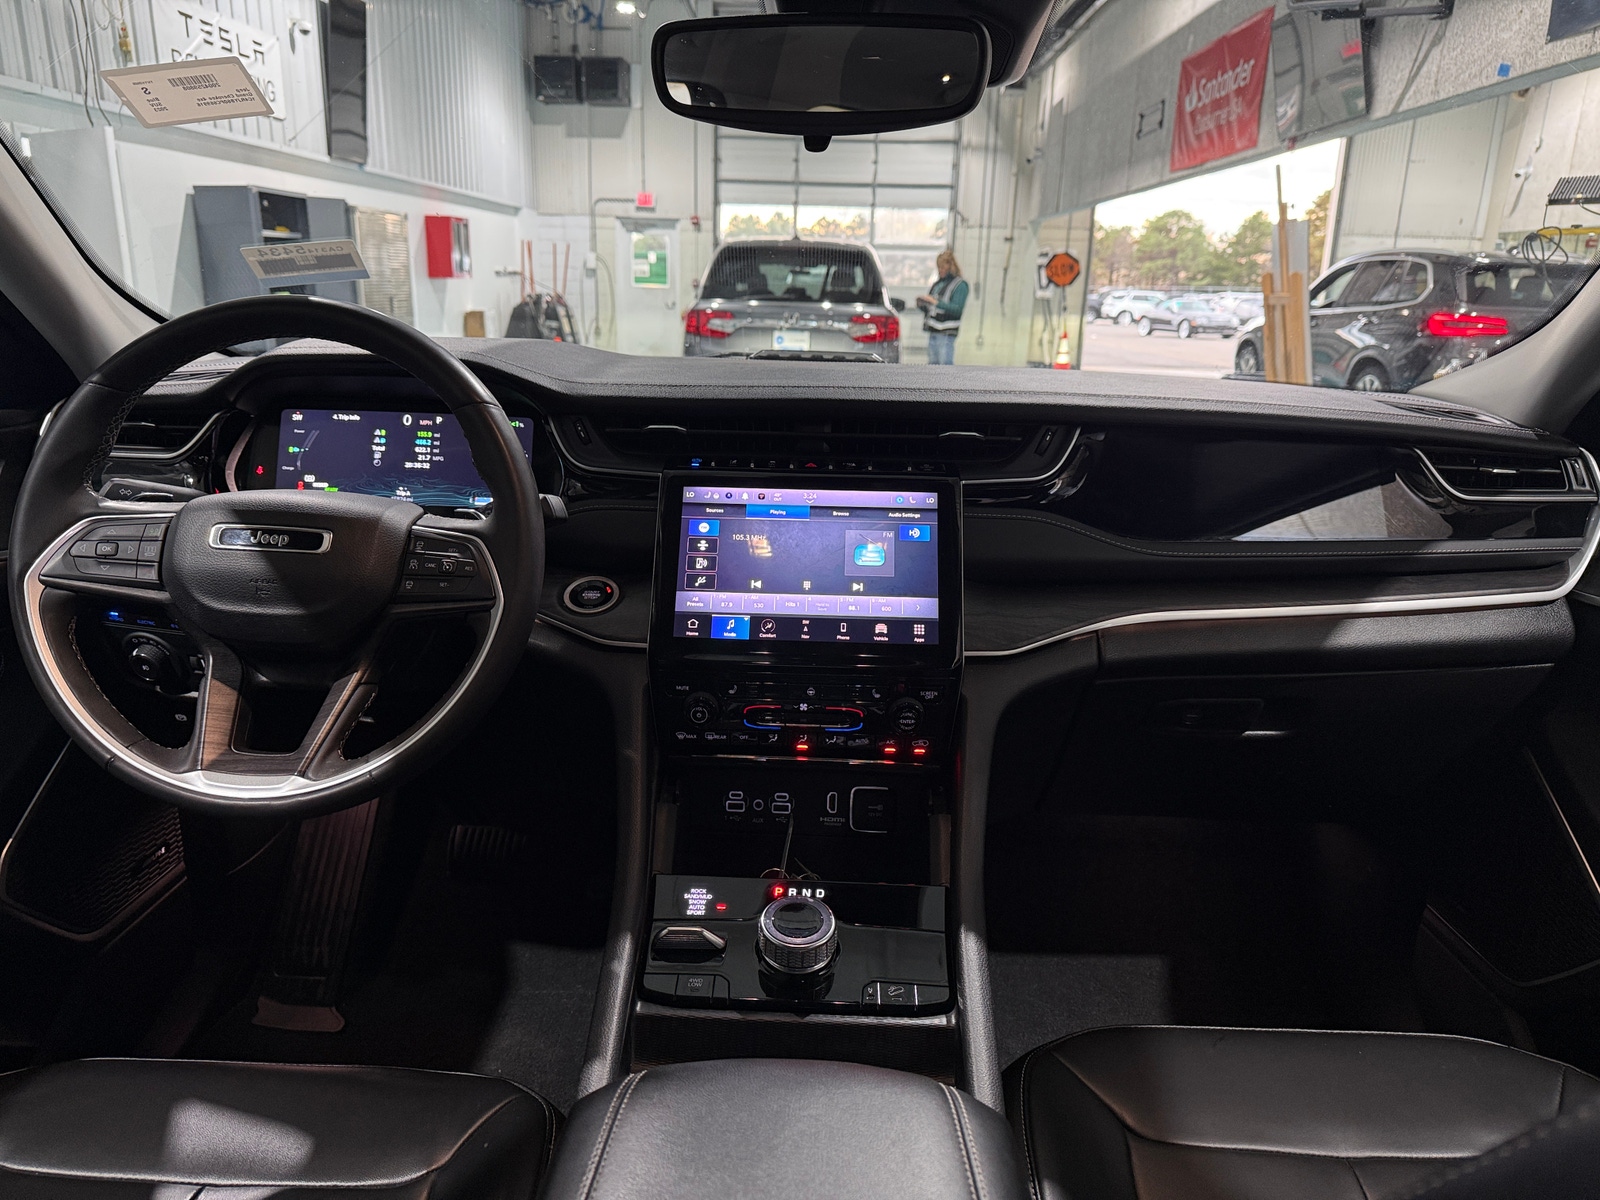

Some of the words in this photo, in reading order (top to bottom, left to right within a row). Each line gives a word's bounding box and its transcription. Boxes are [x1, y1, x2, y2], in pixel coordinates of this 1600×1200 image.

[177, 10, 265, 65] TESLA
[1198, 58, 1255, 106] Santander
[403, 414, 412, 426] 0
[436, 416, 443, 424] P
[250, 530, 290, 547] Jeep
[774, 887, 783, 896] P
[788, 888, 797, 896] R
[802, 888, 811, 897] N
[816, 889, 825, 898] D
